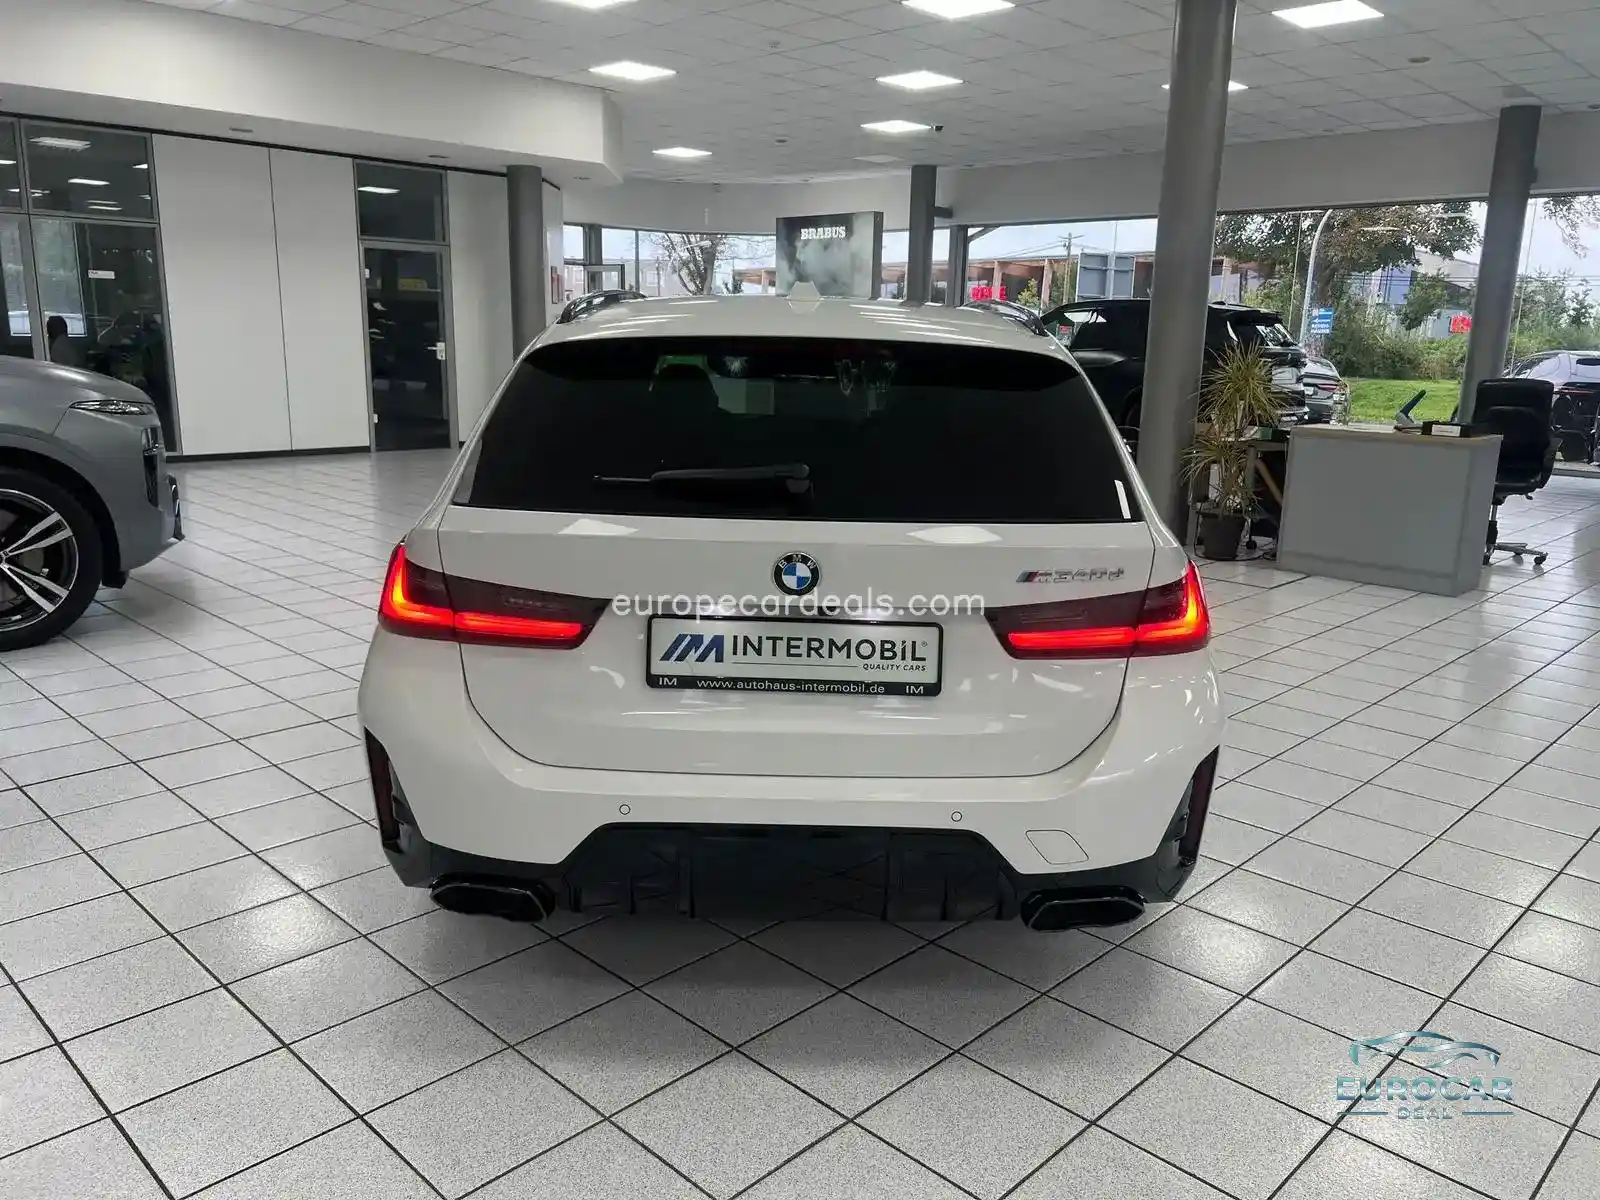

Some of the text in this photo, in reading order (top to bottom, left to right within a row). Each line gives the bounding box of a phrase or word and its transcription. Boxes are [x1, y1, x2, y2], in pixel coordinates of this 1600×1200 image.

[800, 226, 847, 240] BRABUS
[777, 553, 819, 570] BMW
[862, 663, 927, 672] QUALITY CARS
[658, 677, 678, 686] IM
[696, 680, 885, 694] www.autohaus-intermobil.de
[905, 685, 925, 694] IM
